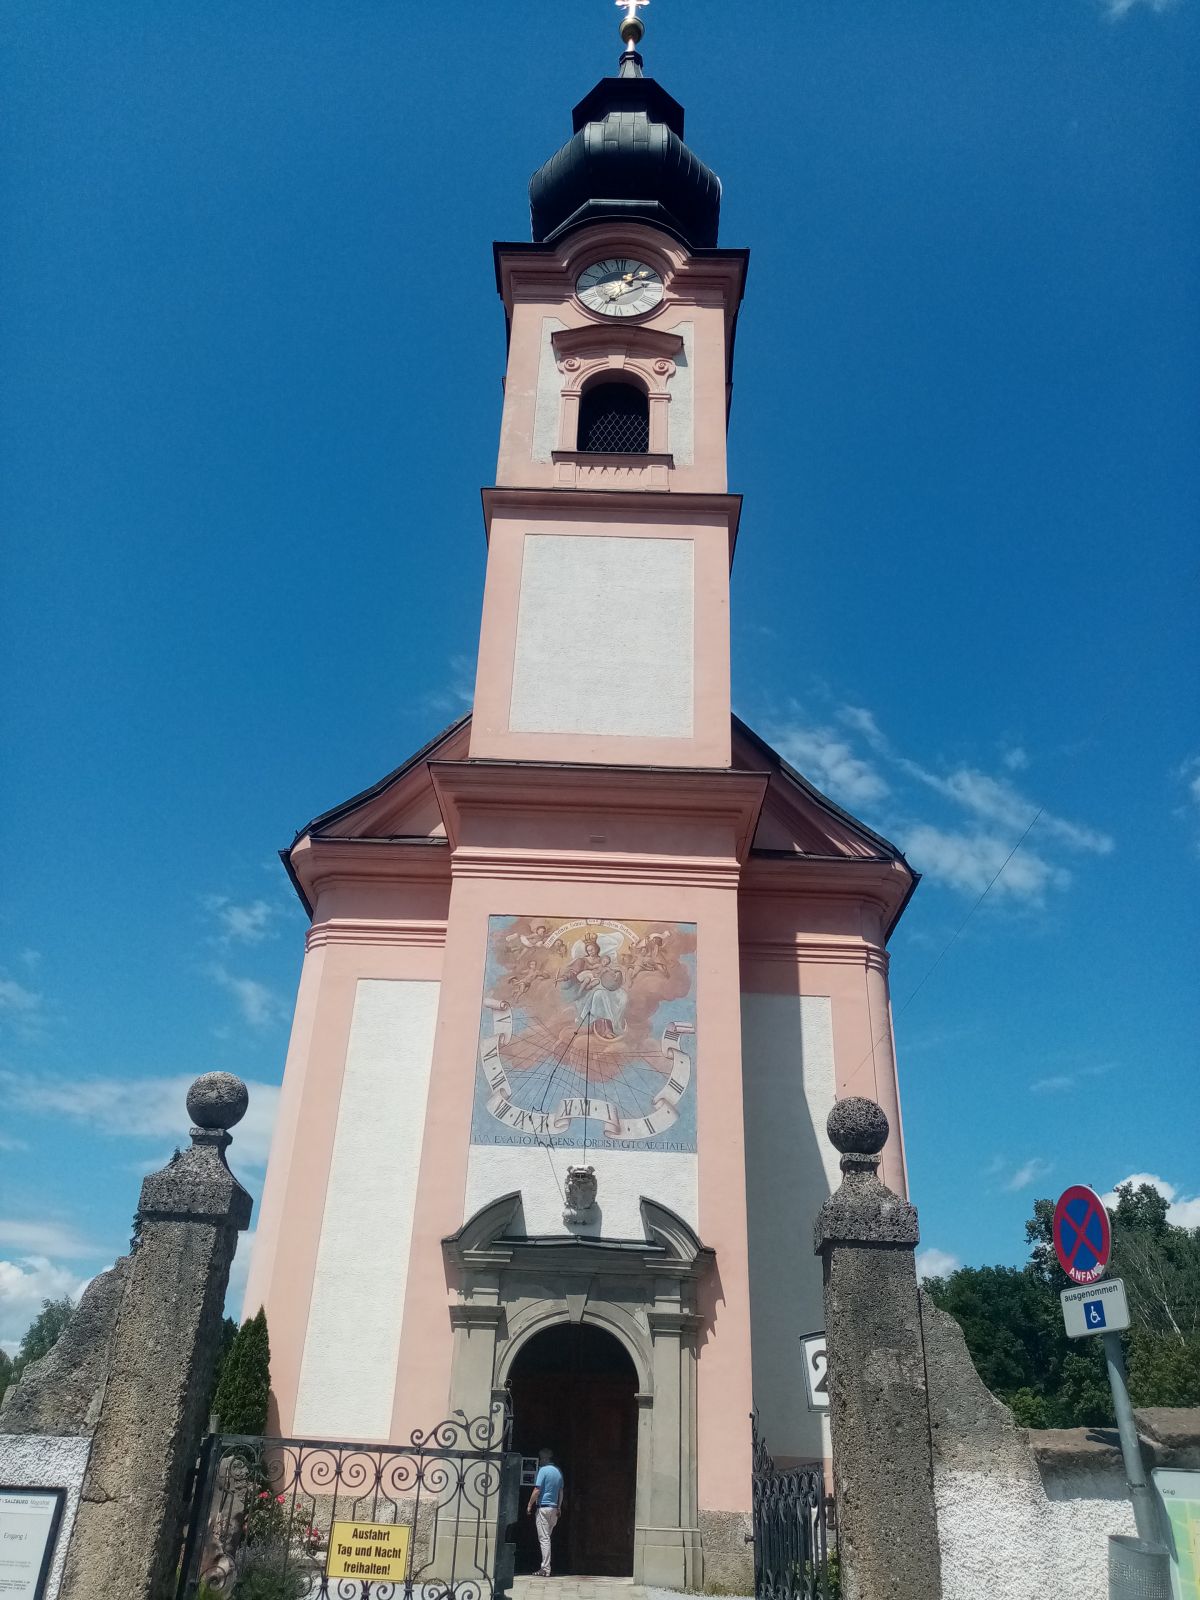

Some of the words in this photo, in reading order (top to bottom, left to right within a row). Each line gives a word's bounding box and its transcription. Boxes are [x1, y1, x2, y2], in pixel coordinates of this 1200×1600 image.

[1069, 1262, 1104, 1282] ANFAN
[1064, 1284, 1118, 1302] ausgenommen
[352, 1528, 390, 1541] Ausfahrt
[337, 1544, 352, 1557] Tag
[355, 1546, 372, 1557] und
[374, 1547, 402, 1559] Nacht
[343, 1561, 391, 1575] freihalten!
